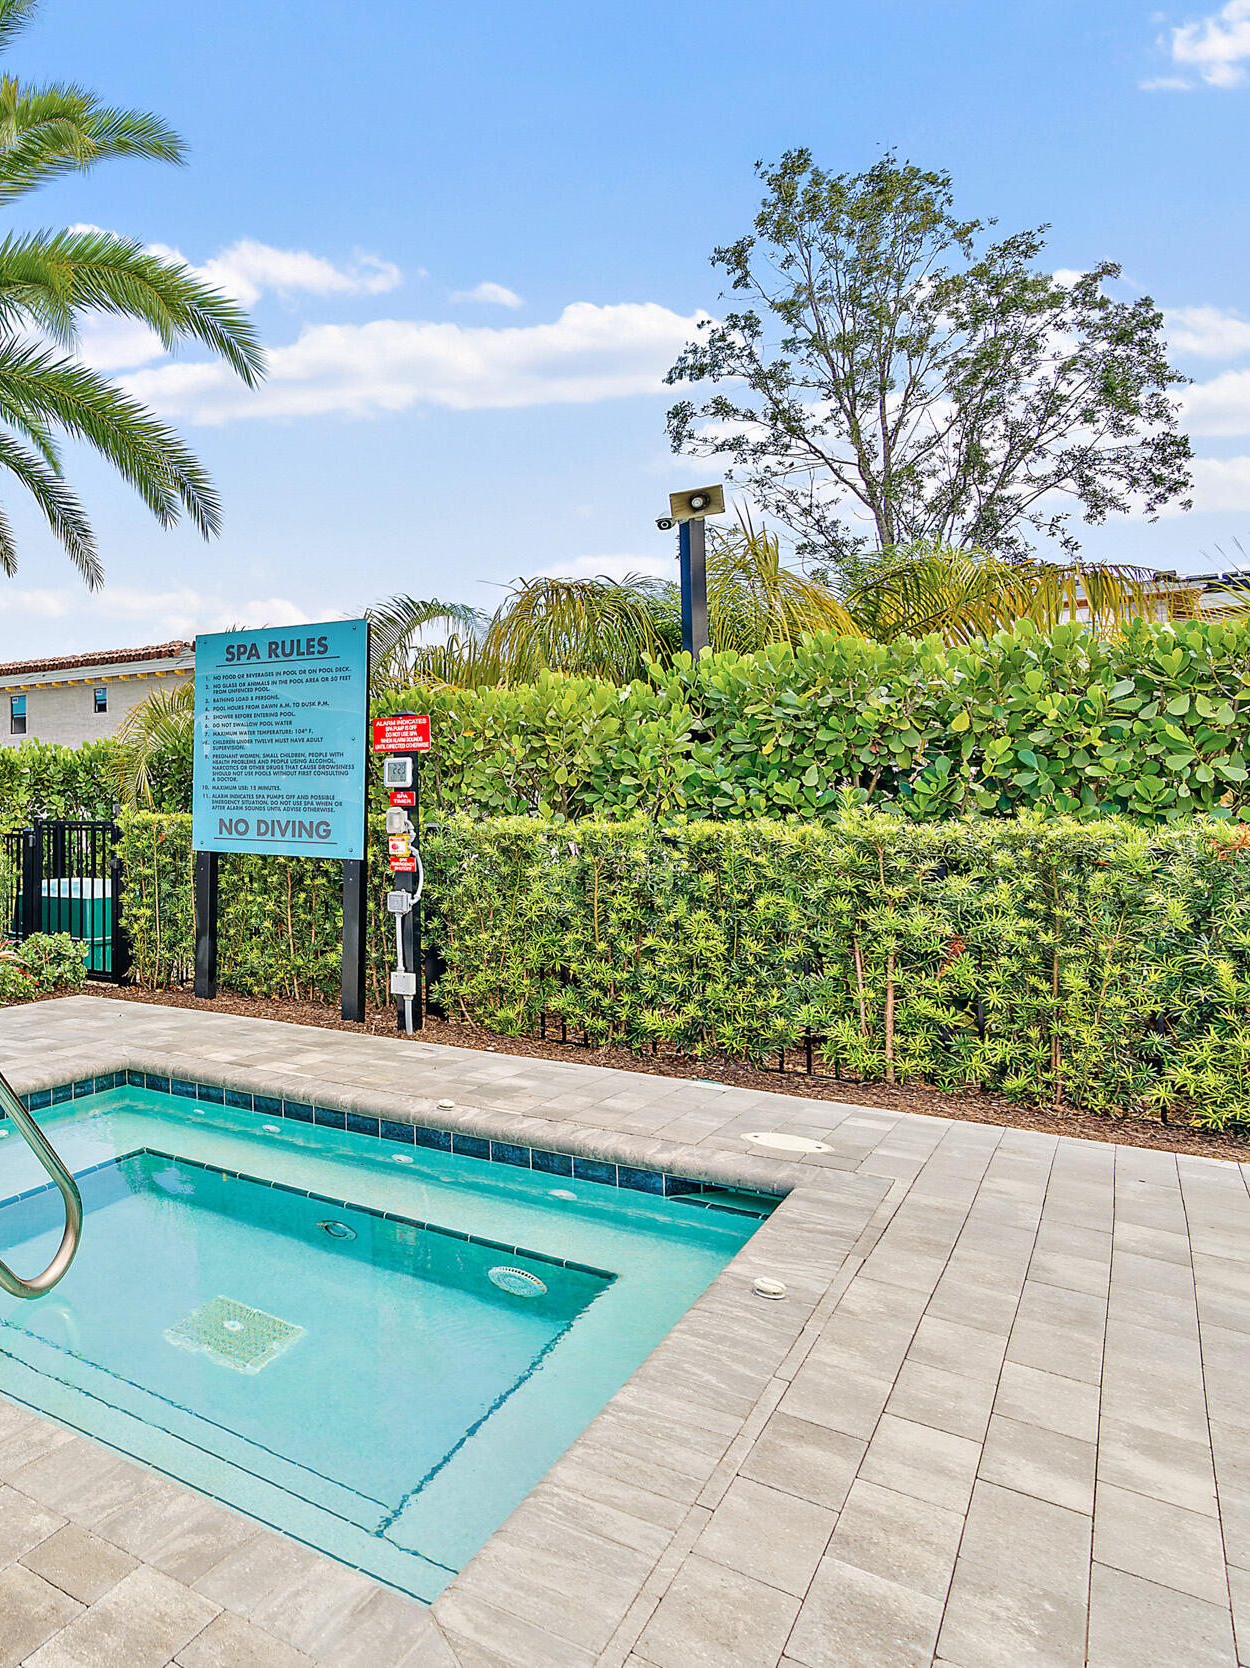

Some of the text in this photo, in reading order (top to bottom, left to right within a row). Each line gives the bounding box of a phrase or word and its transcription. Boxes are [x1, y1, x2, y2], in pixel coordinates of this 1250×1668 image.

[225, 636, 328, 662] SPA RULES
[218, 818, 332, 839] NO DIVING
